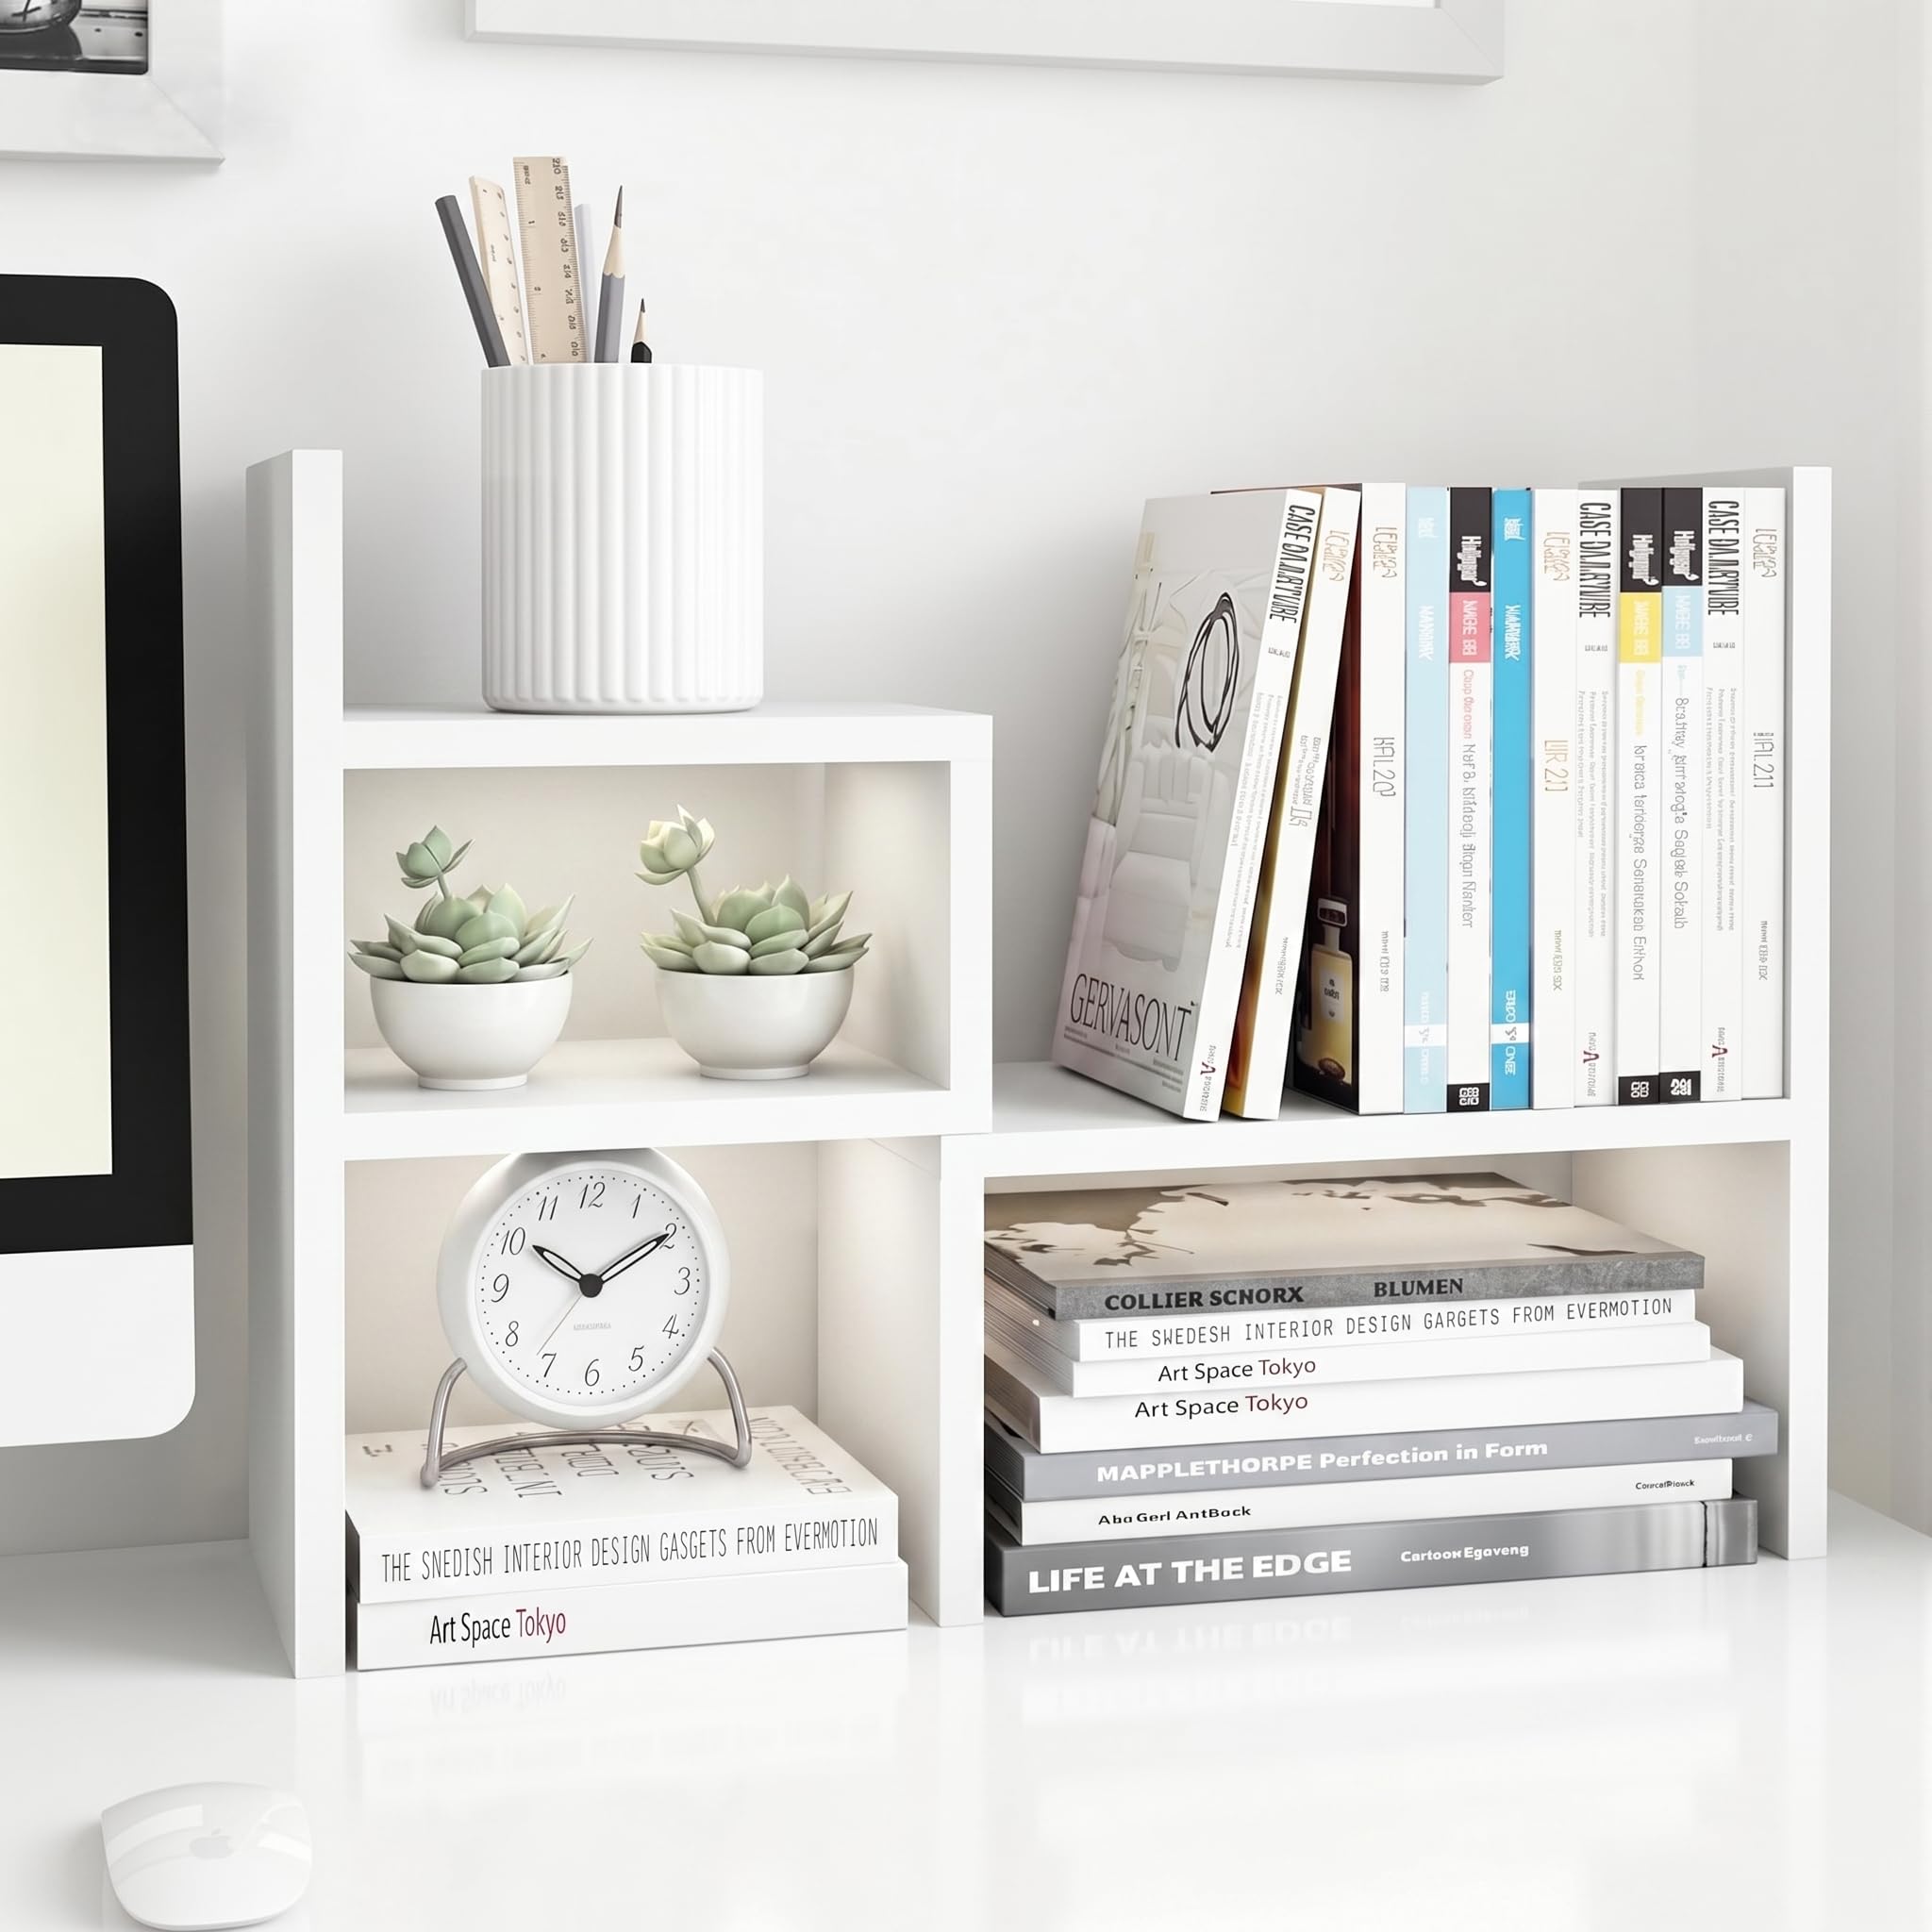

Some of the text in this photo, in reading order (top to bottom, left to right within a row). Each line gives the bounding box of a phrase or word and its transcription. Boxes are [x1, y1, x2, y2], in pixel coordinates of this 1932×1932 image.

[1579, 502, 1611, 536] CASE
[1707, 500, 1740, 535] CASE
[539, 1195, 558, 1221] 11
[579, 1181, 605, 1209] 12
[632, 1194, 641, 1219] 1
[501, 1226, 525, 1256] 10
[659, 1223, 677, 1250] 2
[491, 1274, 509, 1303] 9
[674, 1267, 691, 1295] 3
[1105, 1277, 1464, 1310] COLLIER SCNORX BLUMEN
[505, 1321, 519, 1347] 8
[662, 1314, 679, 1339] 4
[1105, 1297, 1672, 1349] THE SWEDESH INTERIOR DESIGN GARGETS FROM EVERMOTION
[541, 1353, 558, 1377] 7
[584, 1358, 600, 1387] 6
[628, 1345, 644, 1372] 5
[1158, 1357, 1316, 1385] Art Space Tokyo
[1134, 1392, 1308, 1421] Art Space Tokyo
[1097, 1443, 1548, 1483] MAPPLETHORPE Perfection in Form
[382, 1517, 878, 1583] THE SNEDISH INTERIOR DESIGN GASGETS FROM EVERMOTION
[1028, 1550, 1352, 1594] LIFE AT THE EDGE
[429, 1607, 567, 1648] Art Space Tokyo
